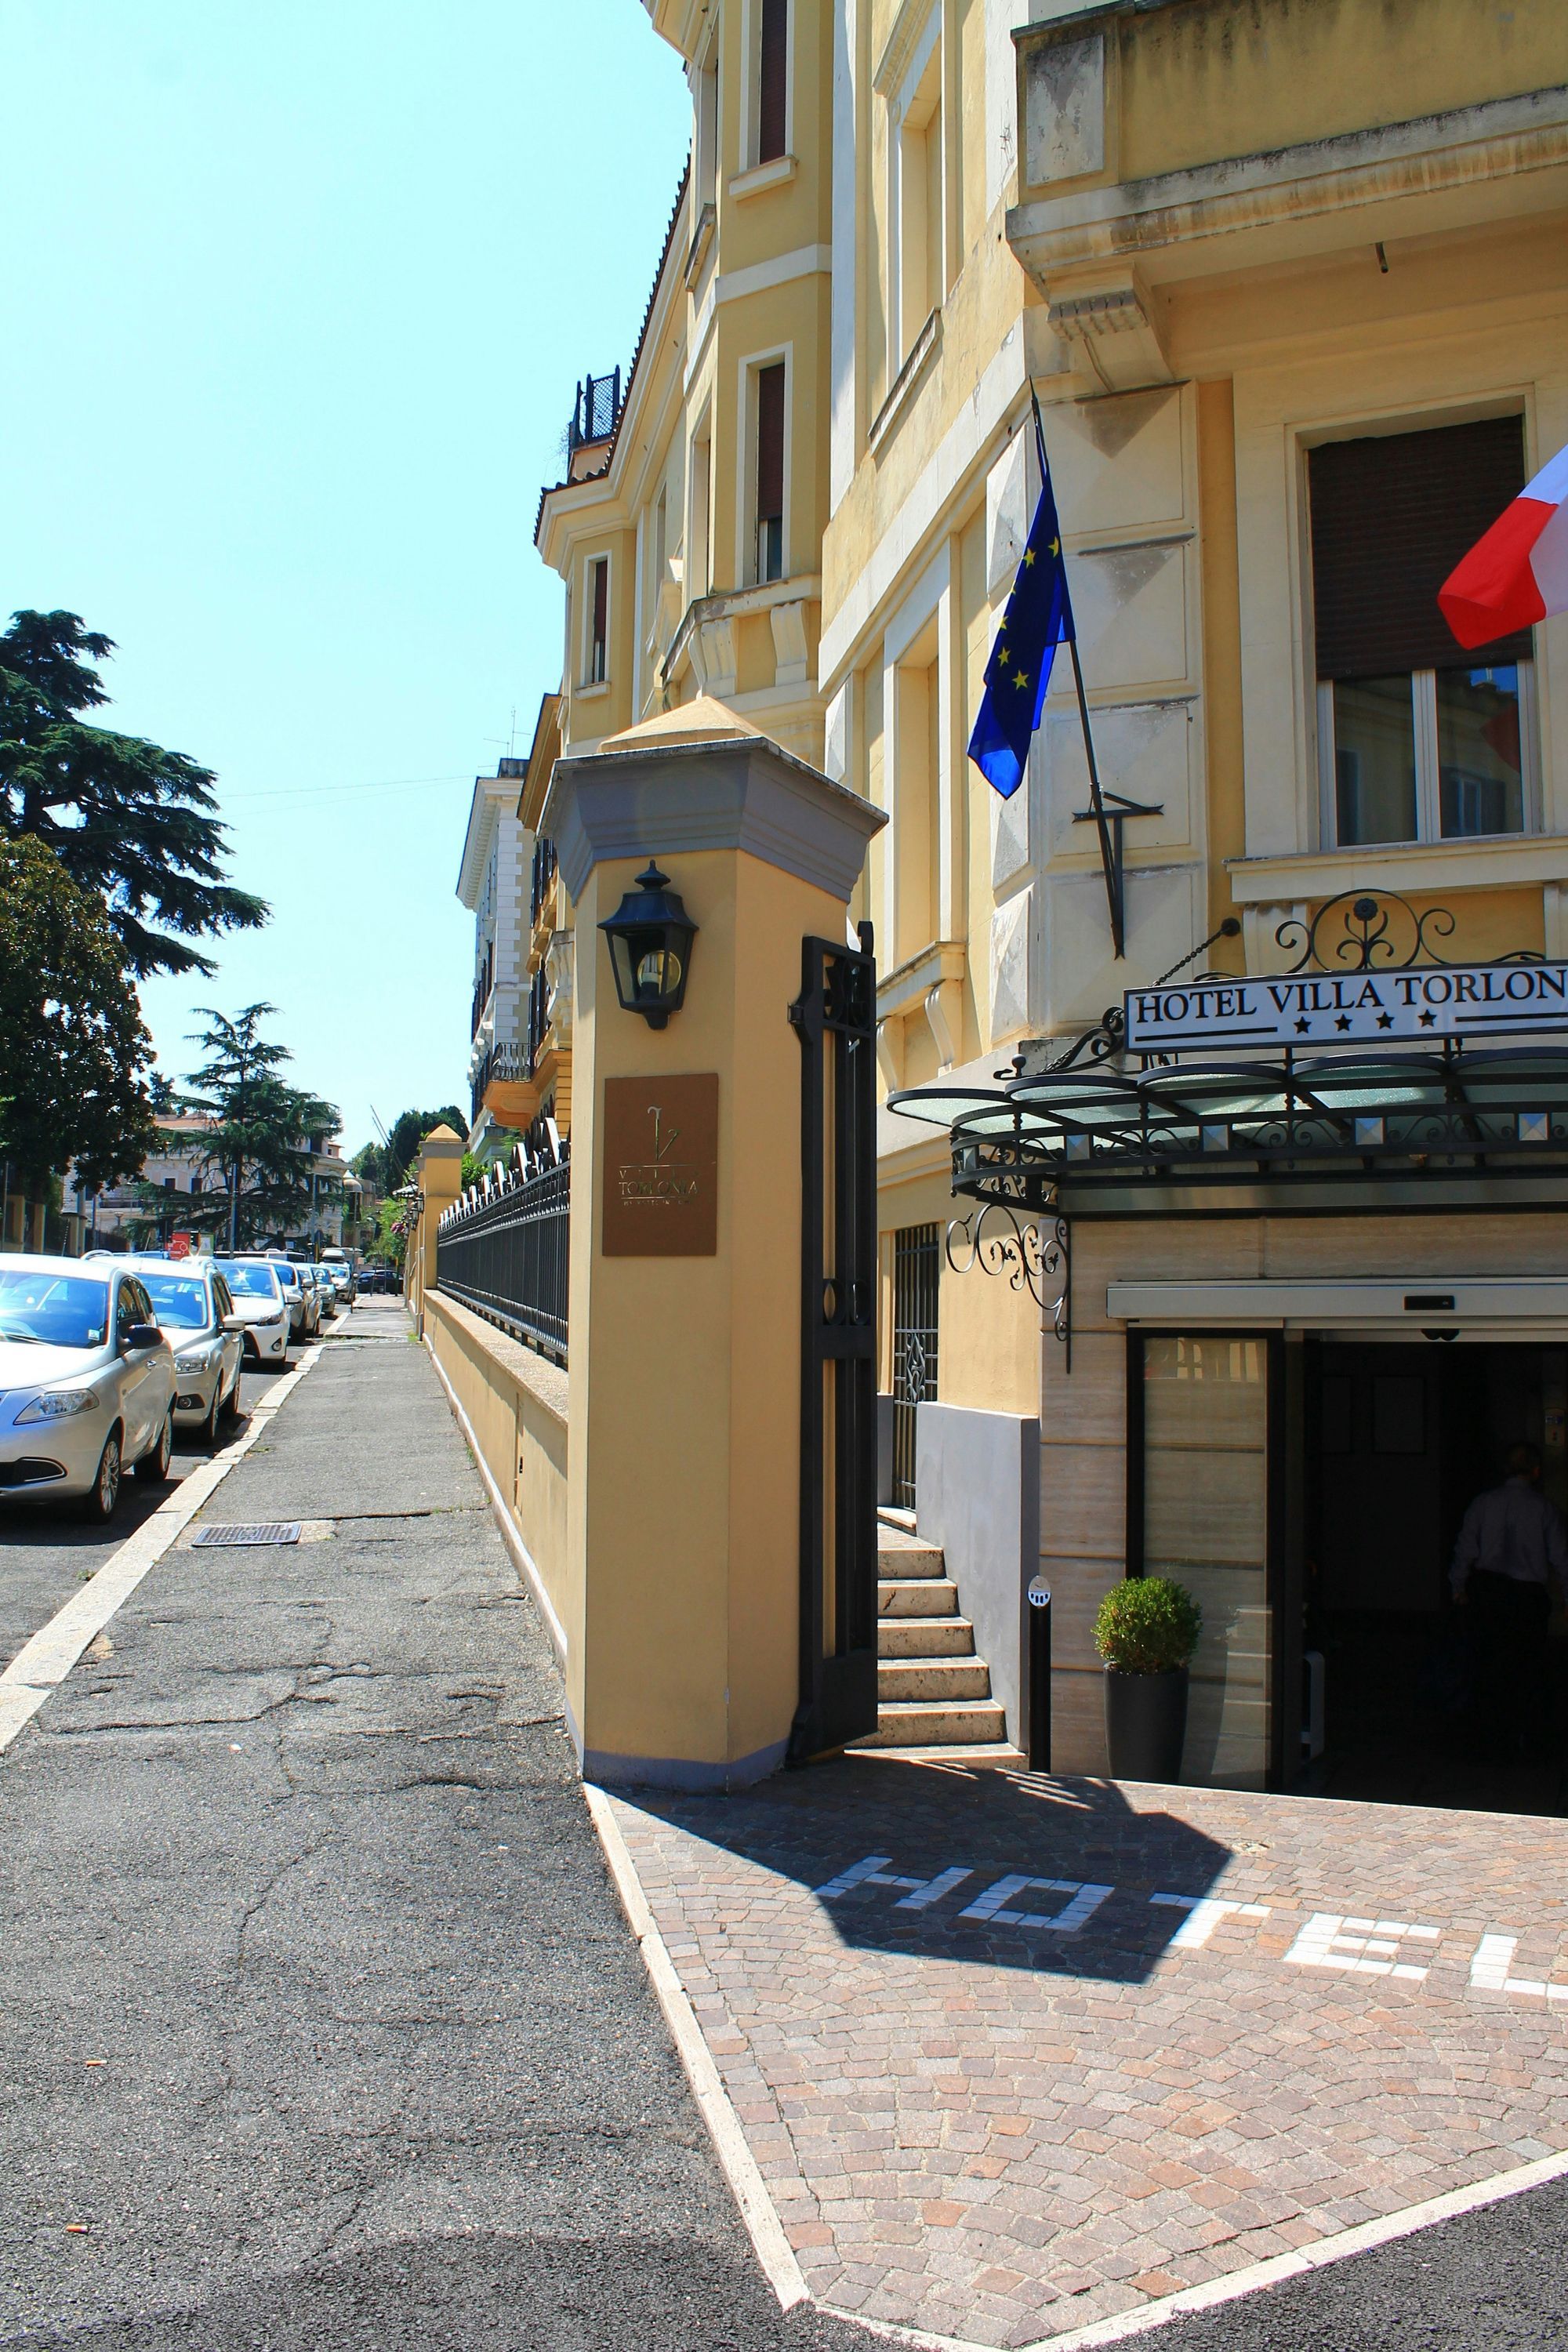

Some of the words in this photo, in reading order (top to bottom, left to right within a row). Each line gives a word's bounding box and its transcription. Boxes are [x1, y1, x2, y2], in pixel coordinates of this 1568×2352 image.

[1135, 988, 1258, 1023] HOTEL
[1266, 979, 1385, 1014] VILLA
[1395, 969, 1567, 1006] TORLON
[815, 1857, 1568, 1998] HOTEL
